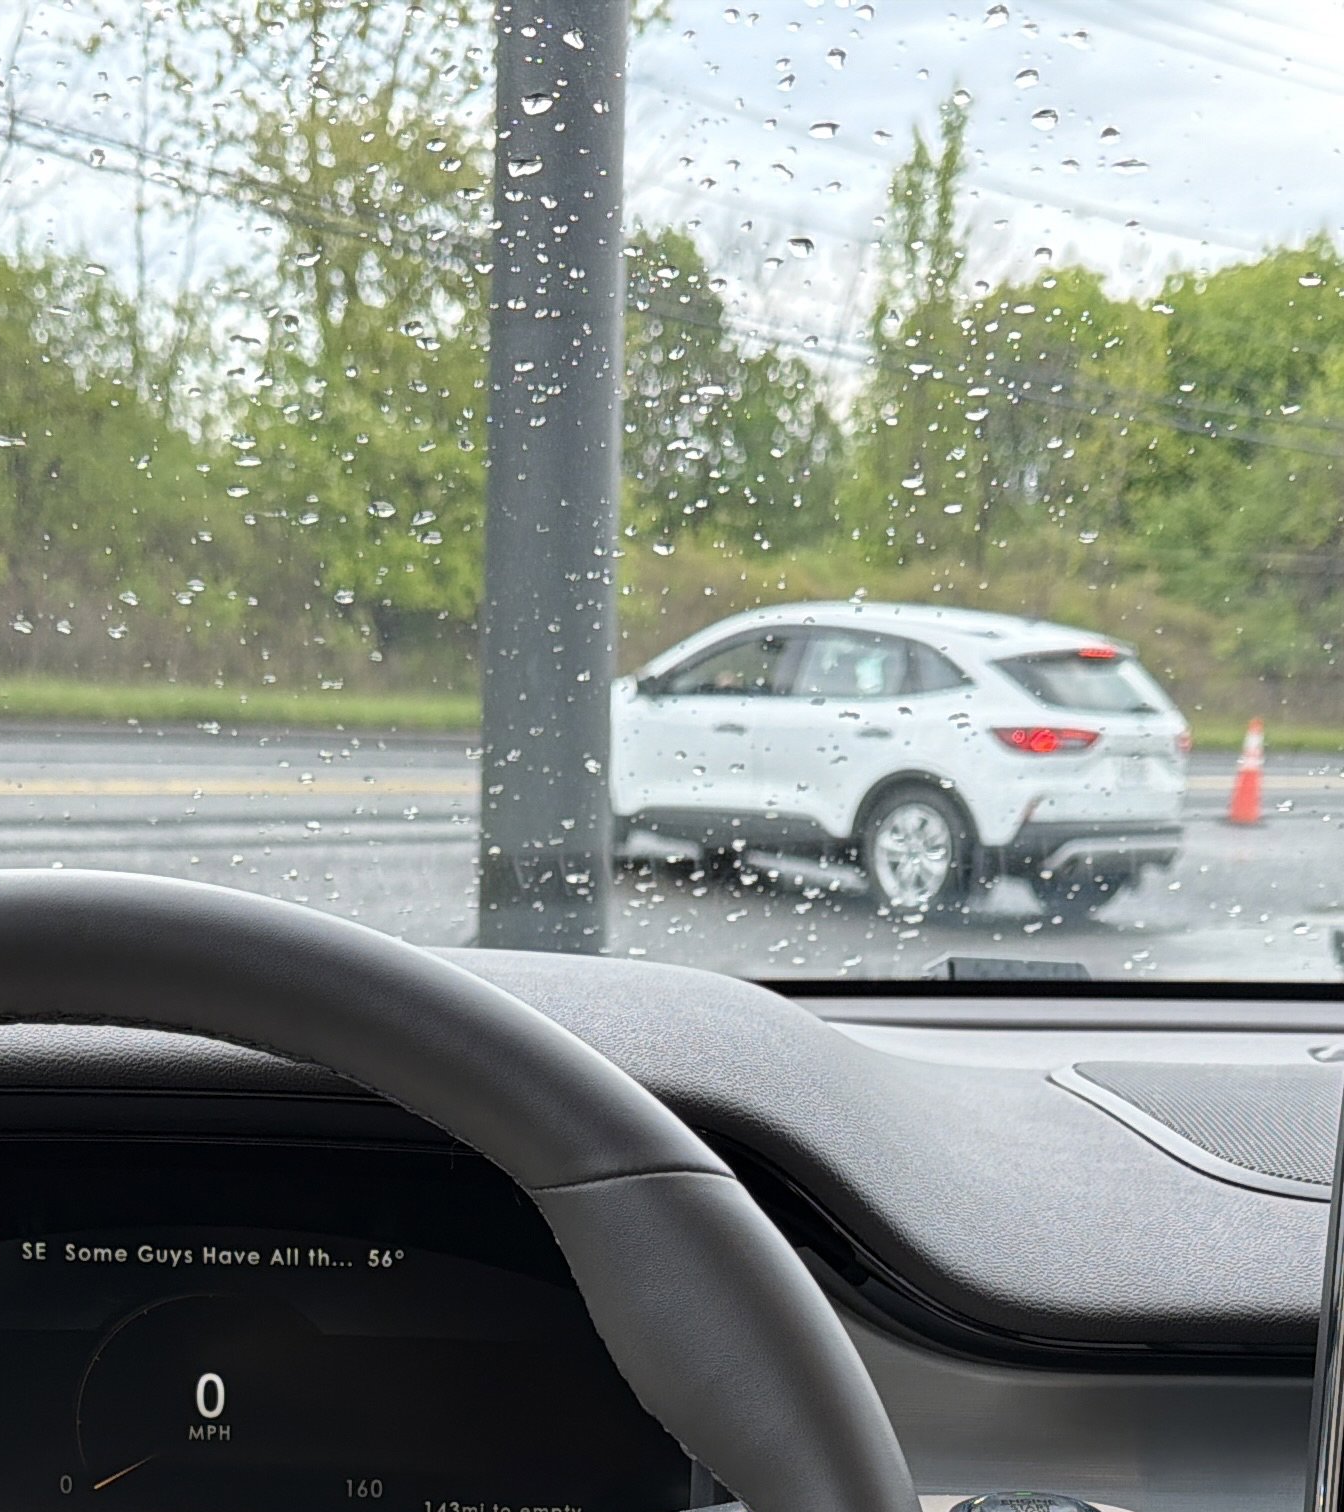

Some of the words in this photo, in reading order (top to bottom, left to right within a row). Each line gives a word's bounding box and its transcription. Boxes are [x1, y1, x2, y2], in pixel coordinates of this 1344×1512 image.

[22, 1242, 47, 1261] SE
[65, 1244, 128, 1263] Some
[137, 1245, 194, 1267] Guys
[203, 1246, 260, 1265] Have
[270, 1248, 299, 1266] All
[367, 1249, 405, 1268] 56°
[196, 1372, 226, 1419] 0
[188, 1424, 232, 1441] MPH
[60, 1475, 73, 1494] 0
[344, 1479, 383, 1499] 160
